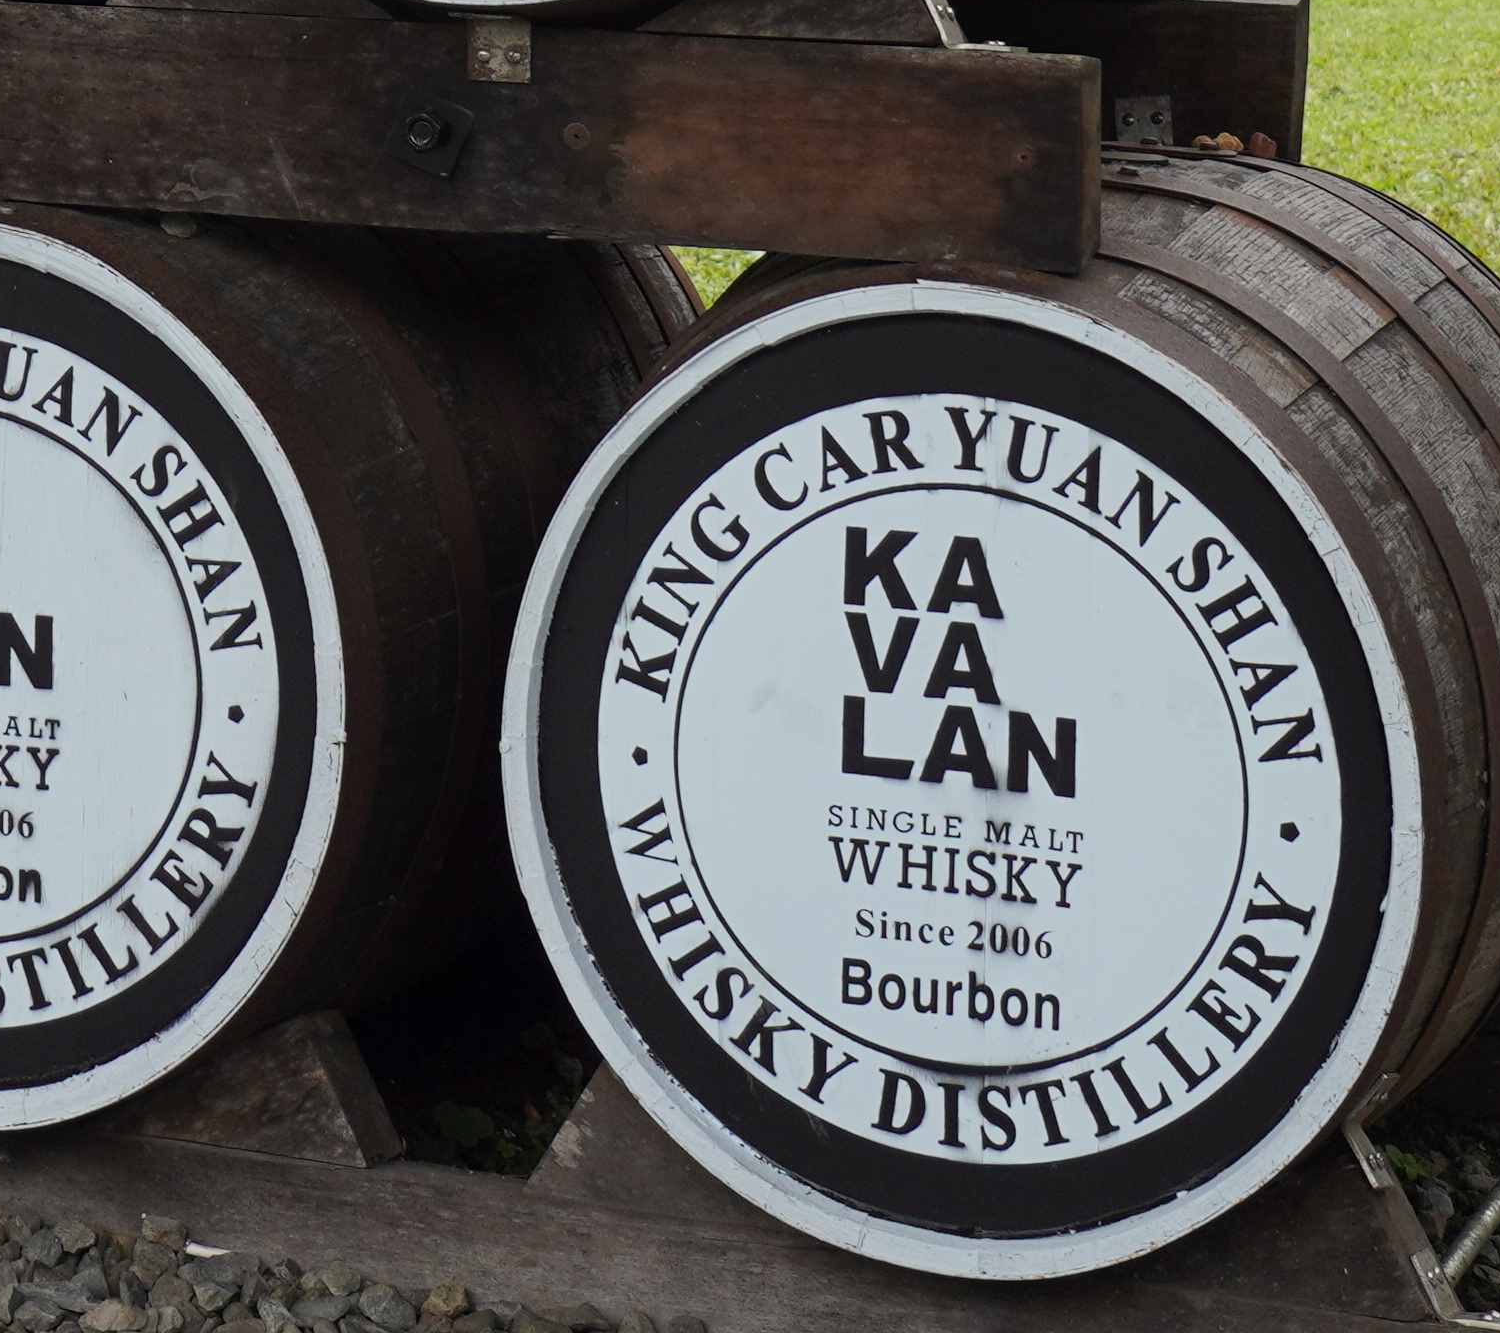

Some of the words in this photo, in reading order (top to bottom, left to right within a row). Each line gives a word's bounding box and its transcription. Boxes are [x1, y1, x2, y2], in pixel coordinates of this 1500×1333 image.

[130, 445, 263, 651] SHAN
[616, 493, 749, 703] KING
[755, 411, 924, 510] CAR
[944, 407, 1180, 547] YUAN
[1166, 537, 1323, 762] SHAN
[844, 527, 1004, 620] KA
[845, 612, 1001, 706] VA
[842, 695, 1076, 798] LAN
[828, 837, 1082, 908] WHISKY
[829, 805, 962, 838] SINGLE
[985, 820, 1083, 853] MALT
[619, 798, 858, 1104] WHISKY
[871, 872, 1316, 1149] DISTILLERY
[856, 909, 954, 946] Since
[968, 921, 1052, 958] 2006
[842, 958, 1059, 1031] Bourbon
